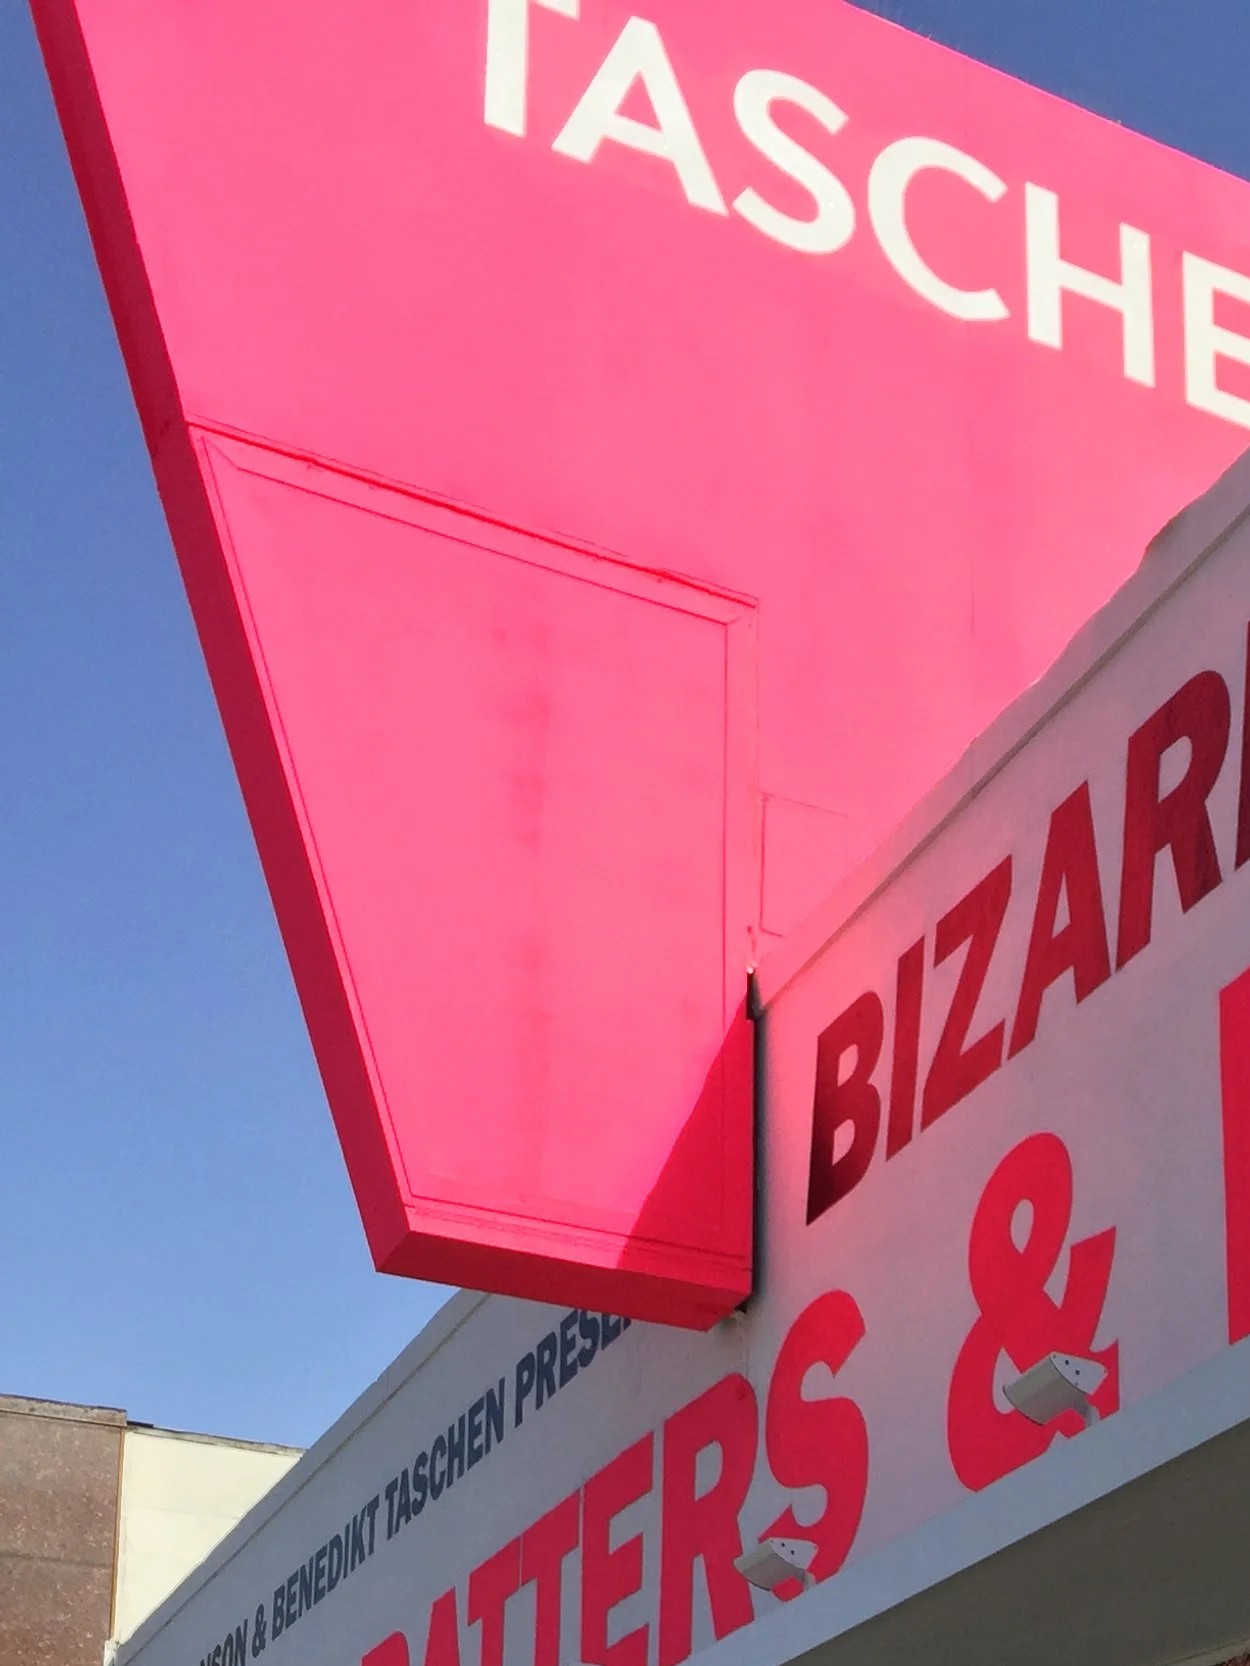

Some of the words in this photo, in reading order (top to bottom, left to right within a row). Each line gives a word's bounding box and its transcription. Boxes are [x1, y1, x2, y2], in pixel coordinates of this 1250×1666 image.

[947, 1132, 1120, 1493] &
[252, 1603, 267, 1658] &
[272, 1494, 379, 1641] BENEDIKT
[385, 1377, 505, 1541] TASCHEN
